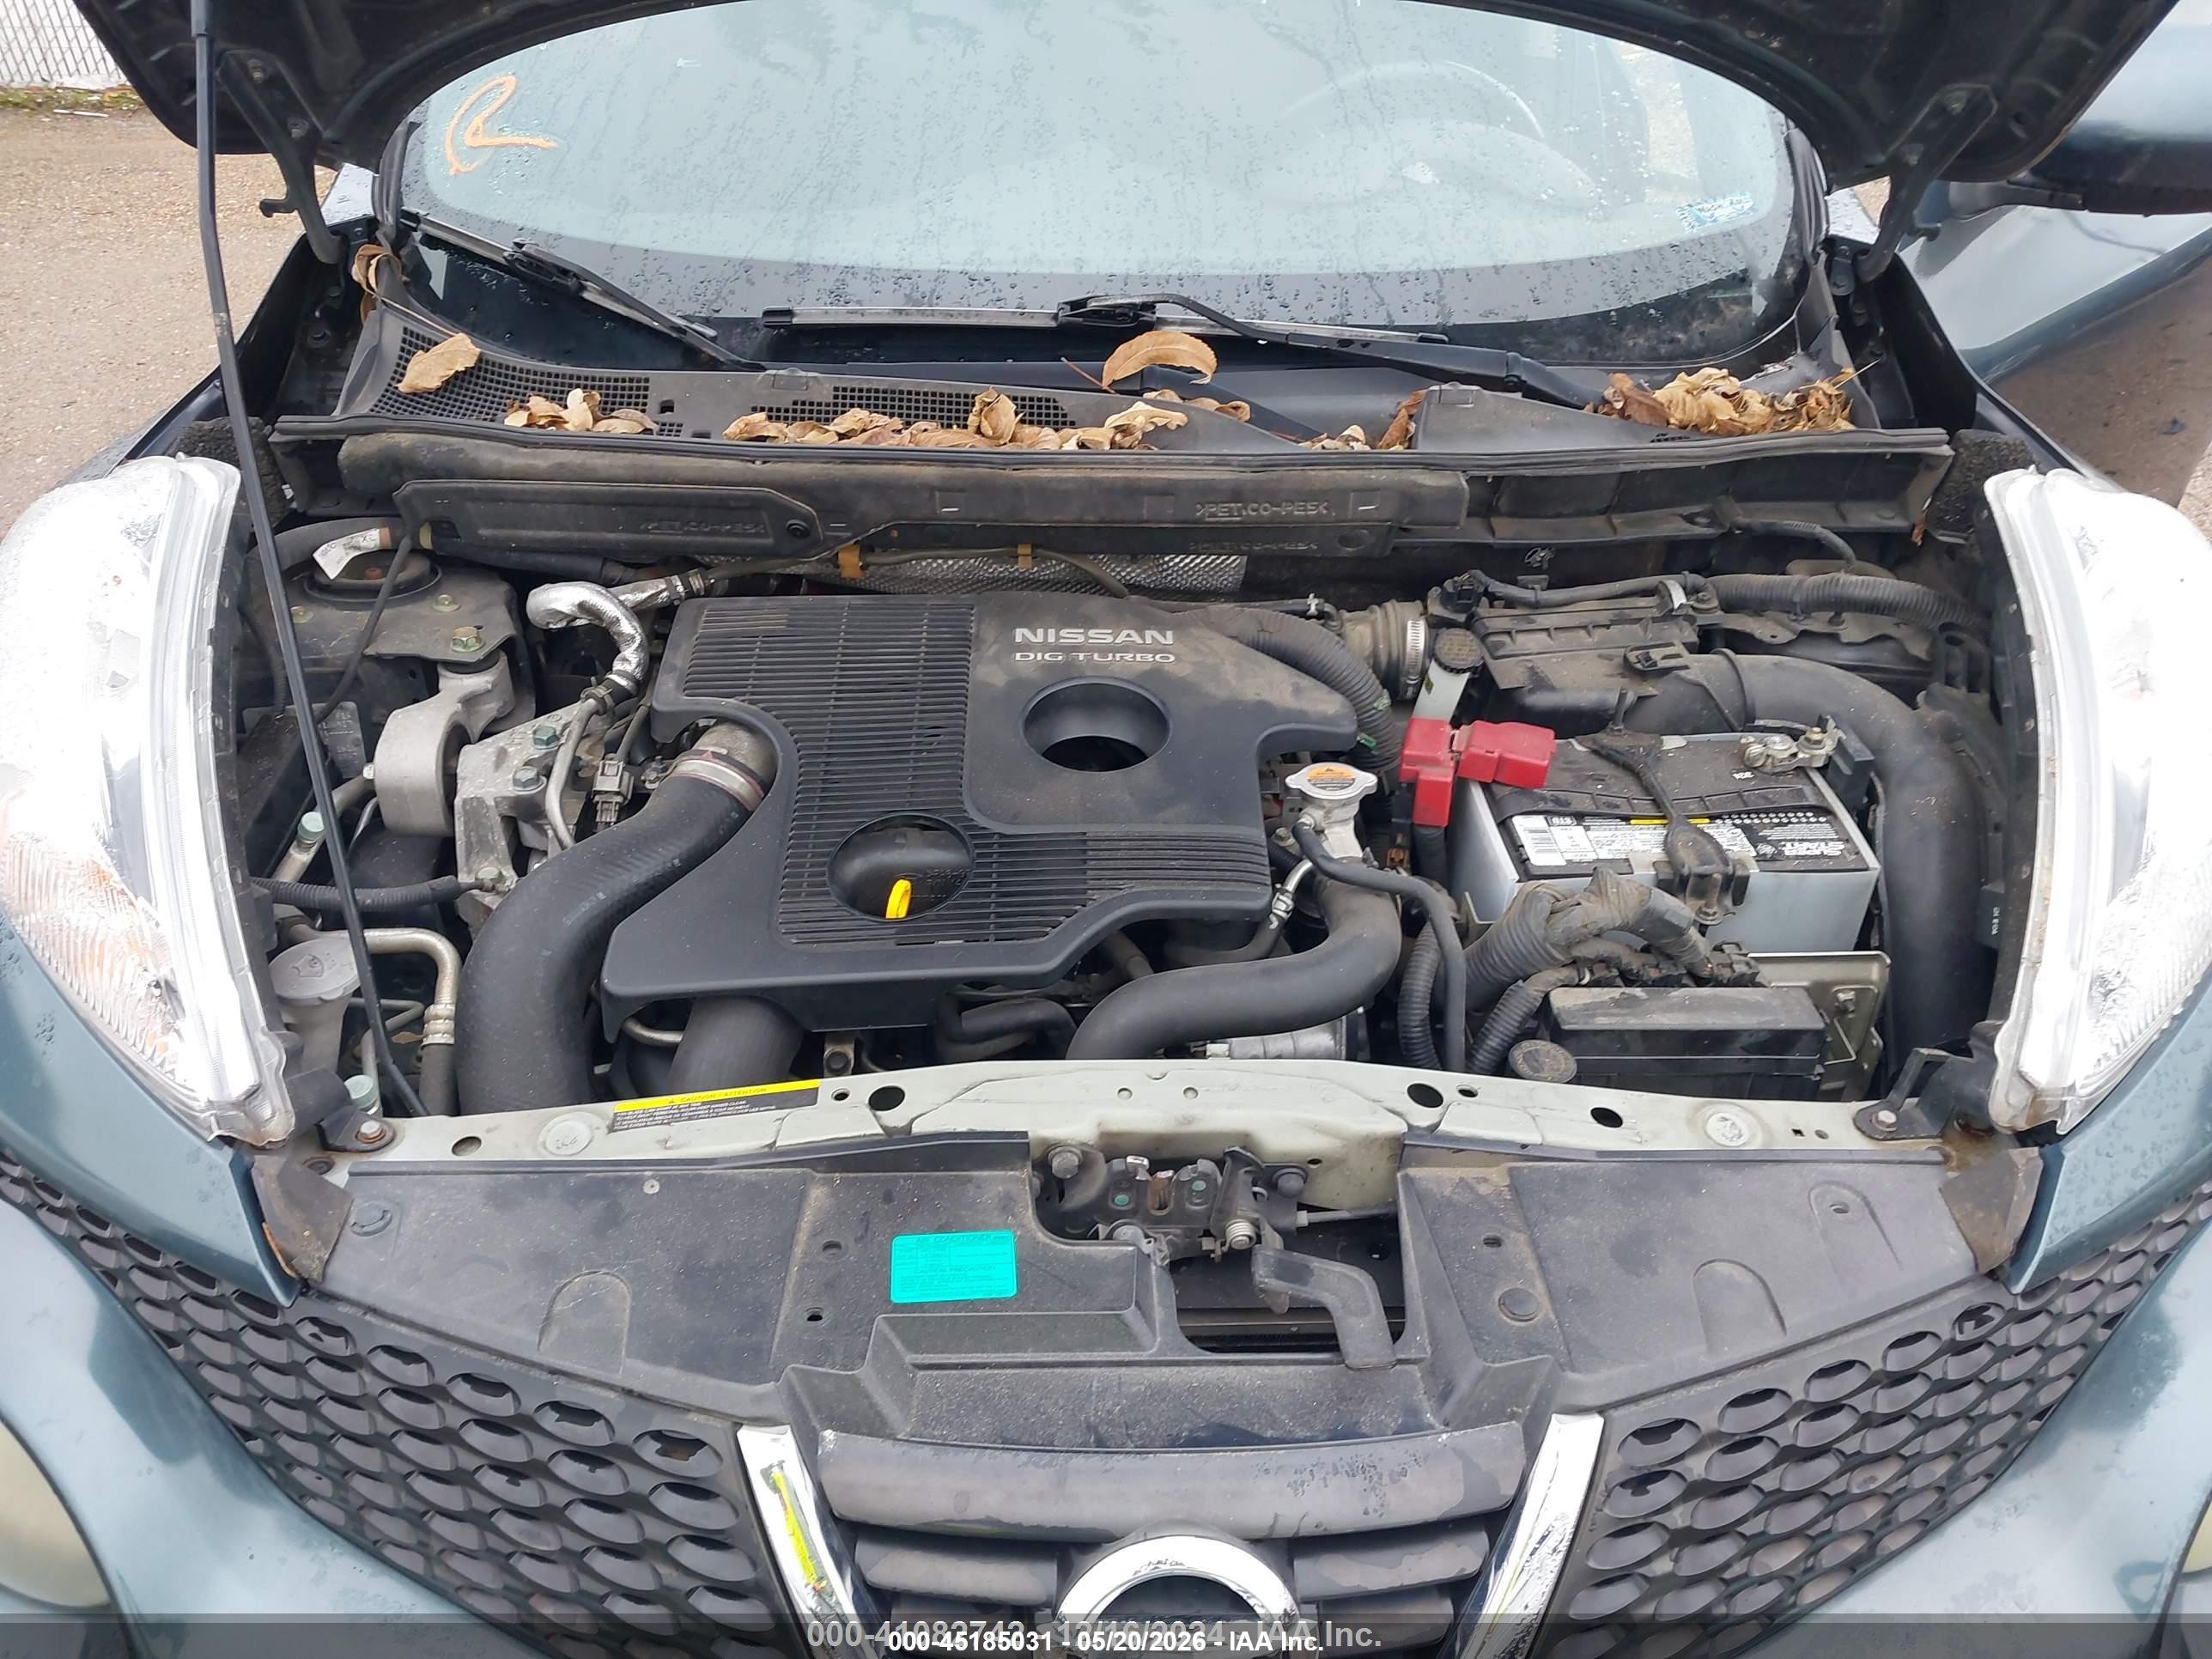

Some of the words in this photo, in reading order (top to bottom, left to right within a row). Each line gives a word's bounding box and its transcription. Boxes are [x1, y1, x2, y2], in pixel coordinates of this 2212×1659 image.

[1014, 628, 1174, 645] NISSAN
[1014, 652, 1064, 661] DIG
[1070, 652, 1176, 662] TURBO
[680, 1093, 715, 1103] CAUTION
[724, 1087, 767, 1097] ATTENTION
